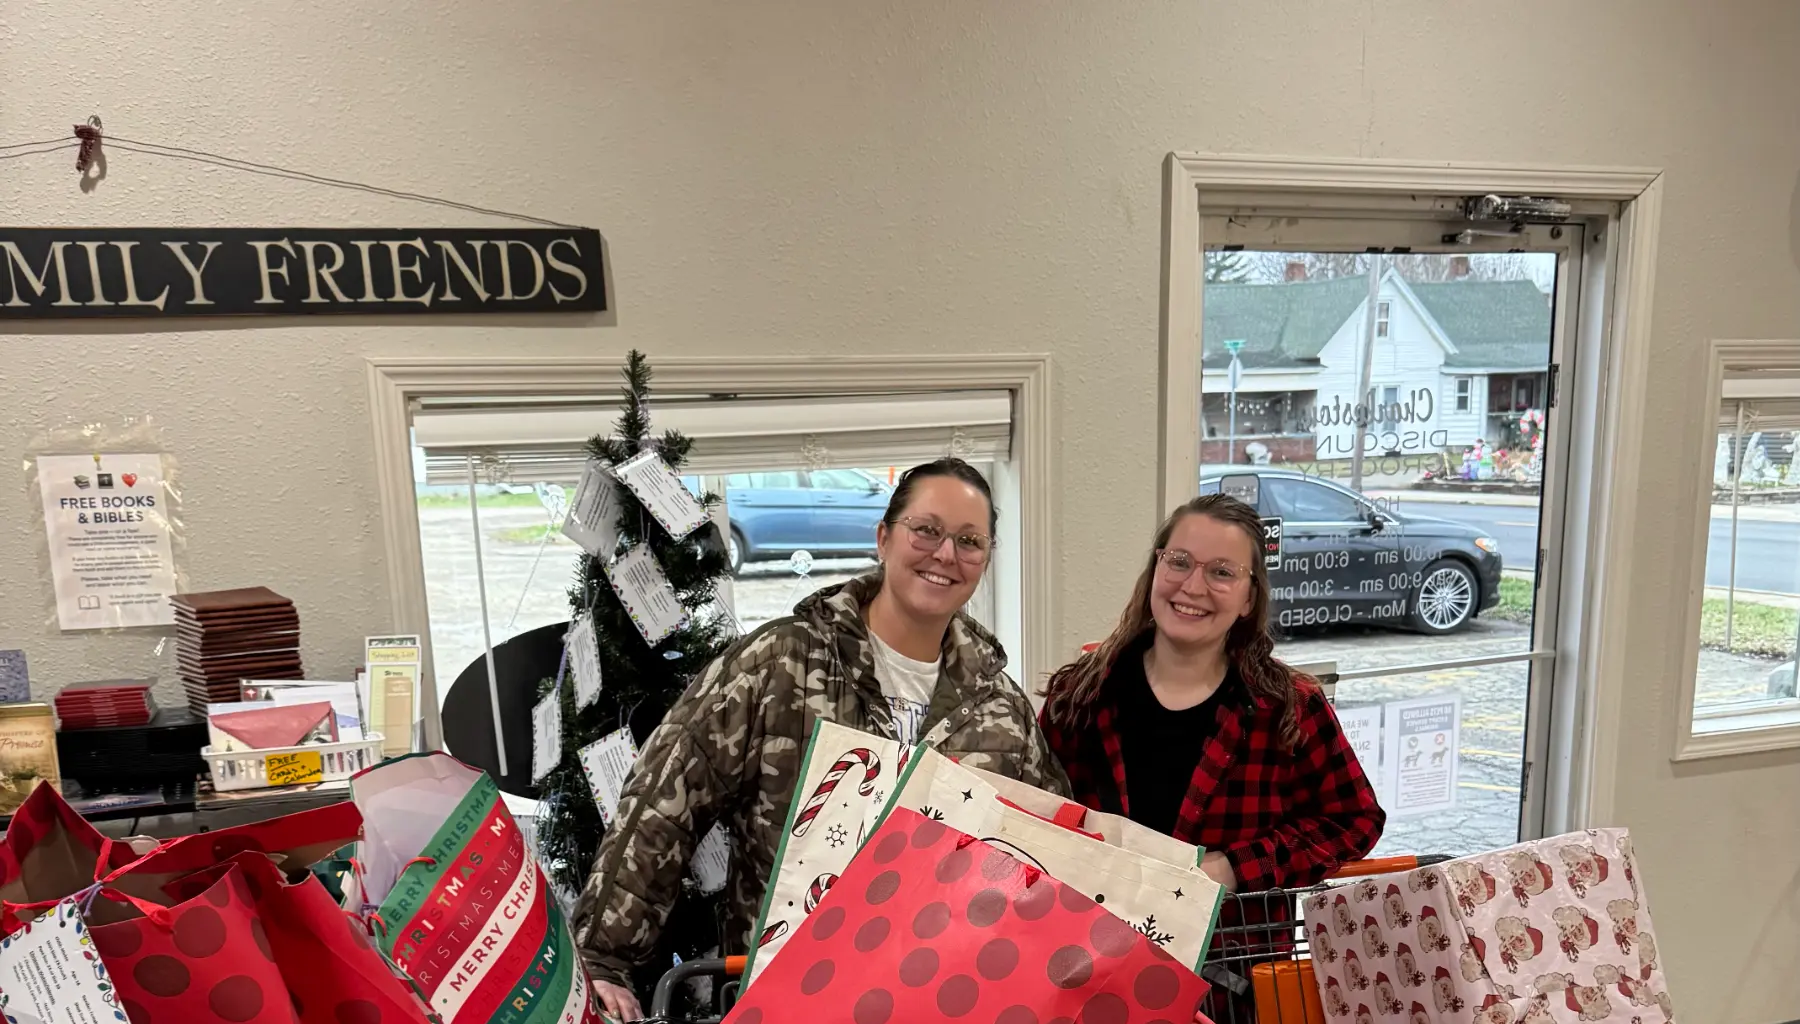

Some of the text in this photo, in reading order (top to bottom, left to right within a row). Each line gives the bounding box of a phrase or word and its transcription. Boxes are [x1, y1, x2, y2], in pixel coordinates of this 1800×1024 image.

[0, 236, 589, 311] MILY FRIENDS
[60, 495, 155, 509] FREE BOOKS
[78, 510, 144, 524] & BIBLES
[268, 753, 298, 767] FREE
[384, 778, 497, 933] MERRY CHRISTMAS
[397, 852, 484, 972] CHRISTMAS
[419, 886, 493, 985] RISTMAS
[450, 922, 504, 992] MERRY
